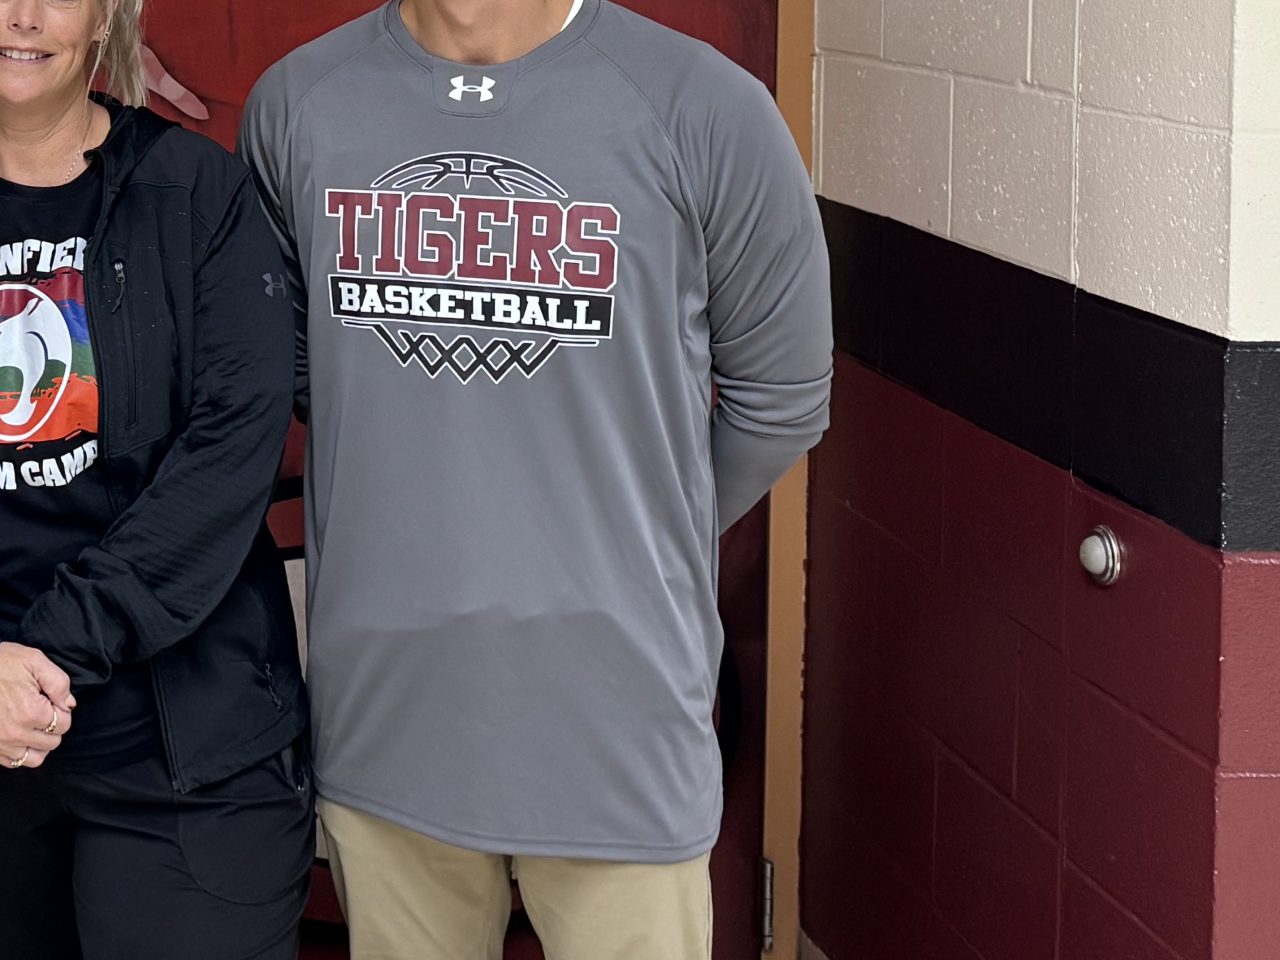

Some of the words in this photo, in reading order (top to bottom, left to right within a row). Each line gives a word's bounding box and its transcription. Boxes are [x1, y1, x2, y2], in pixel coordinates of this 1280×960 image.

[325, 188, 620, 292] TIGERS
[338, 281, 601, 331] BASKETBALL
[20, 439, 98, 487] CAMP
